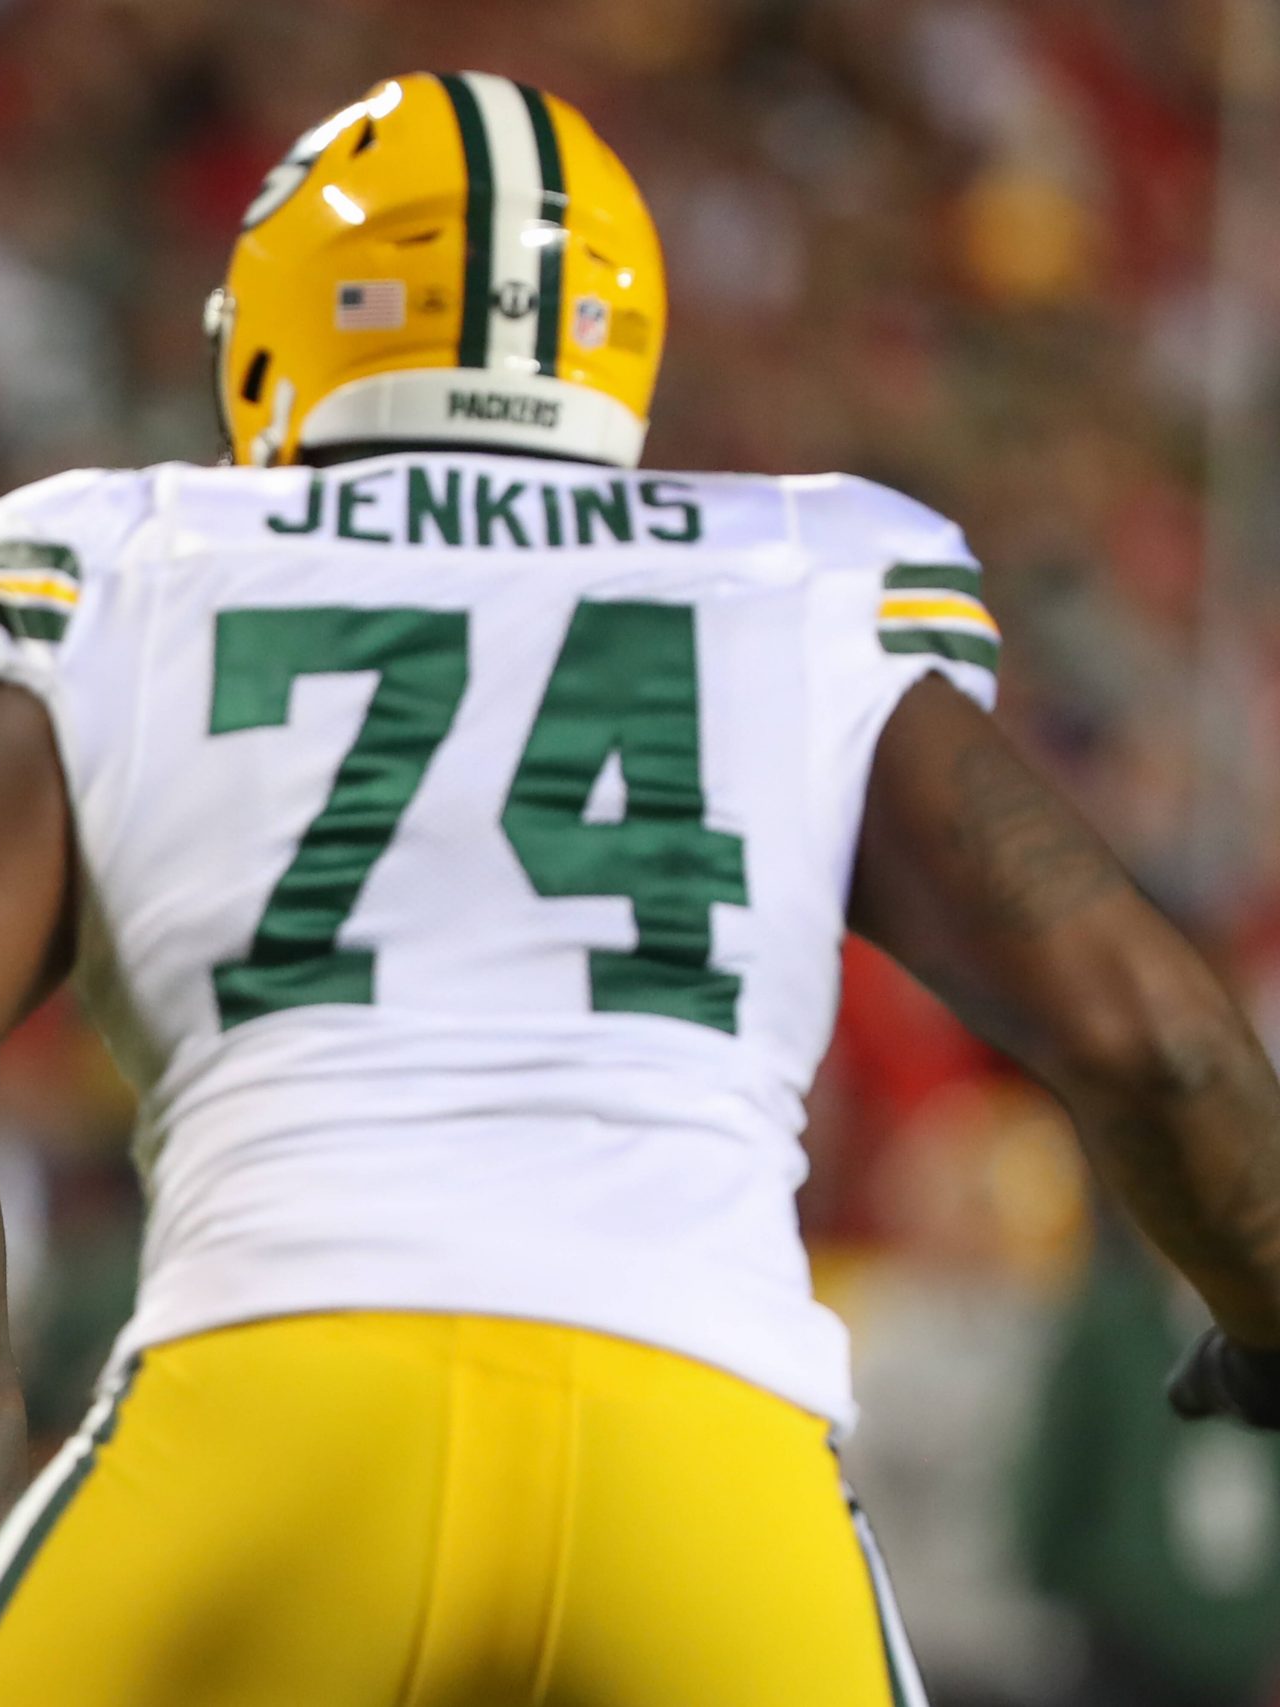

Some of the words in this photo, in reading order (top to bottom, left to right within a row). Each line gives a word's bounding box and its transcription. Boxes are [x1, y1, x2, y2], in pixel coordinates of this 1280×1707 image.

[447, 391, 560, 428] PACKERS
[266, 464, 703, 549] JENKINS
[209, 595, 750, 1036] 74
